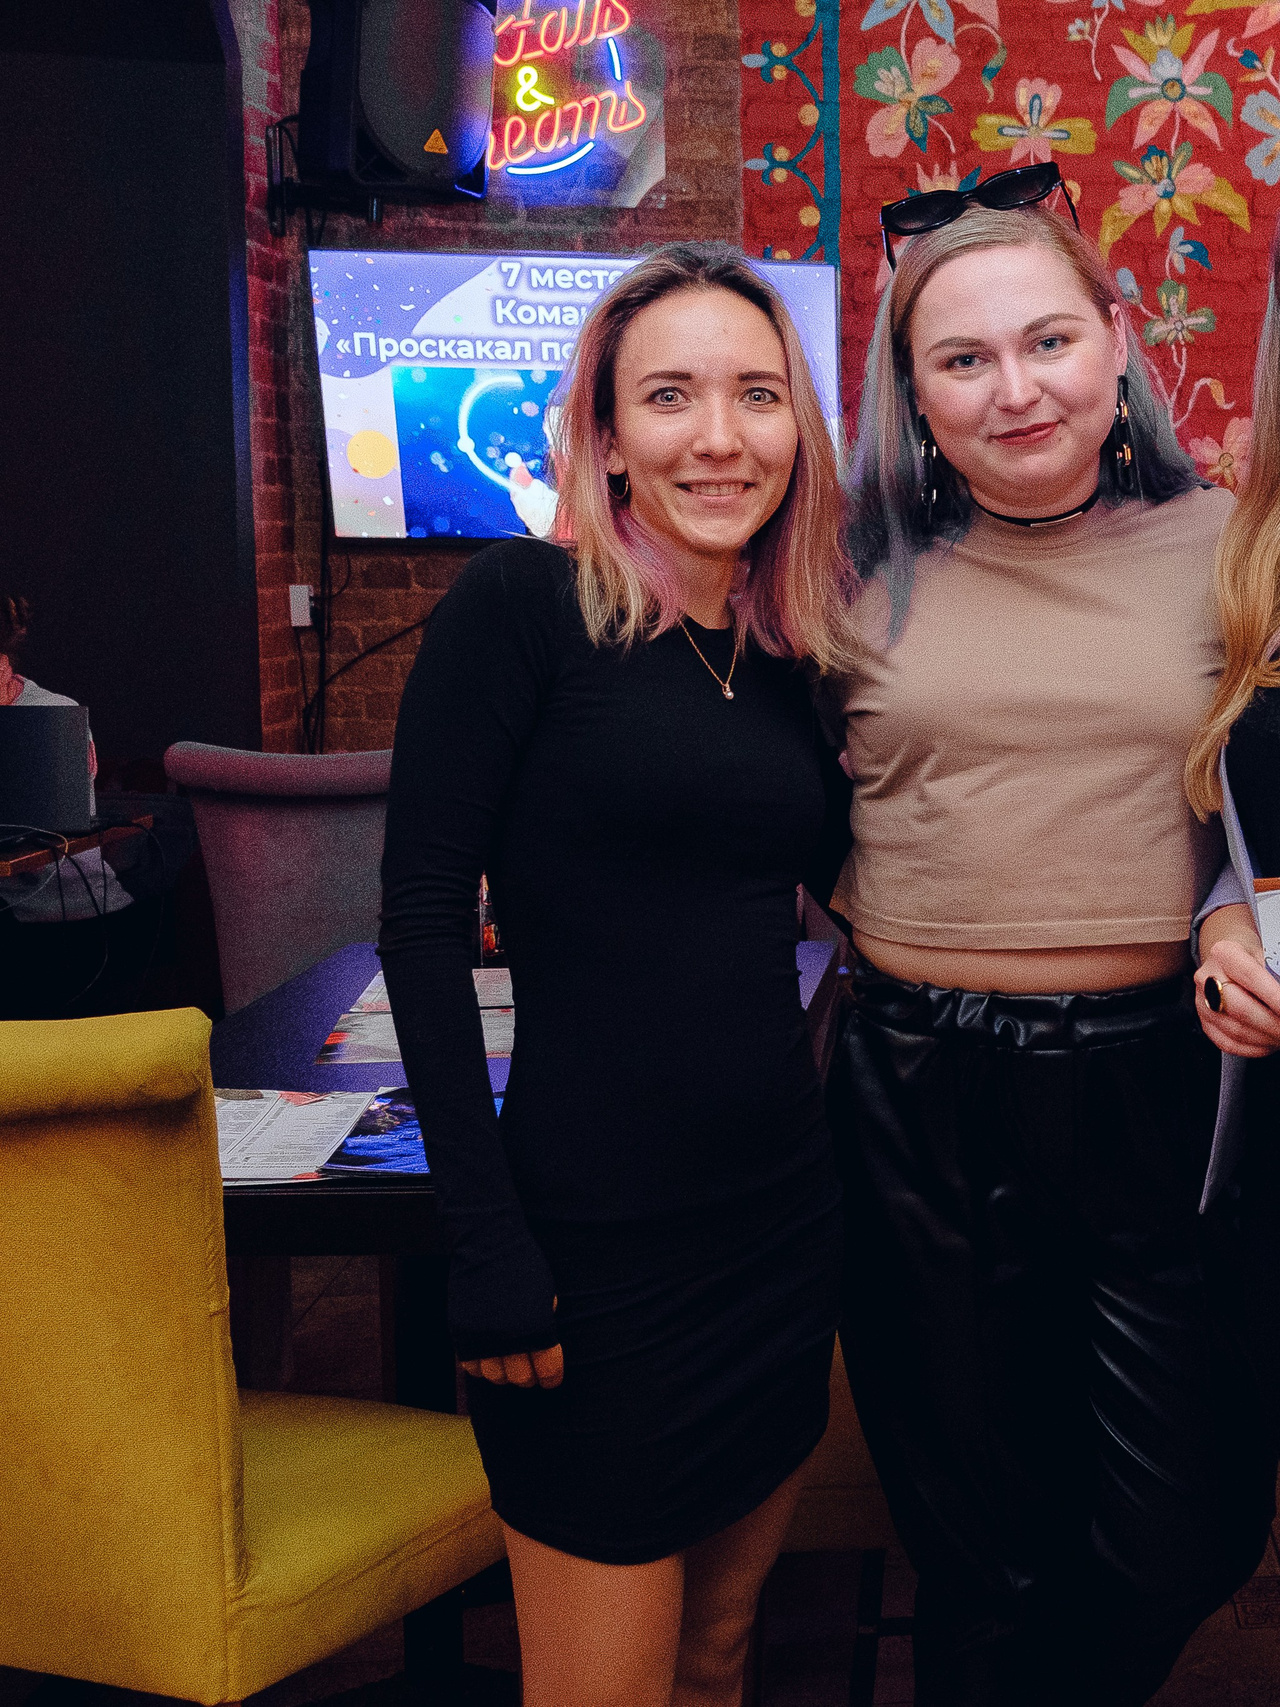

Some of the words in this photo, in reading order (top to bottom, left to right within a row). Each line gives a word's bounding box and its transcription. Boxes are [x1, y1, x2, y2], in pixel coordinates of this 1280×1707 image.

[516, 66, 554, 111] &
[501, 262, 521, 287] 7
[496, 299, 587, 326] Кома
[336, 331, 532, 362] «Проскакал
